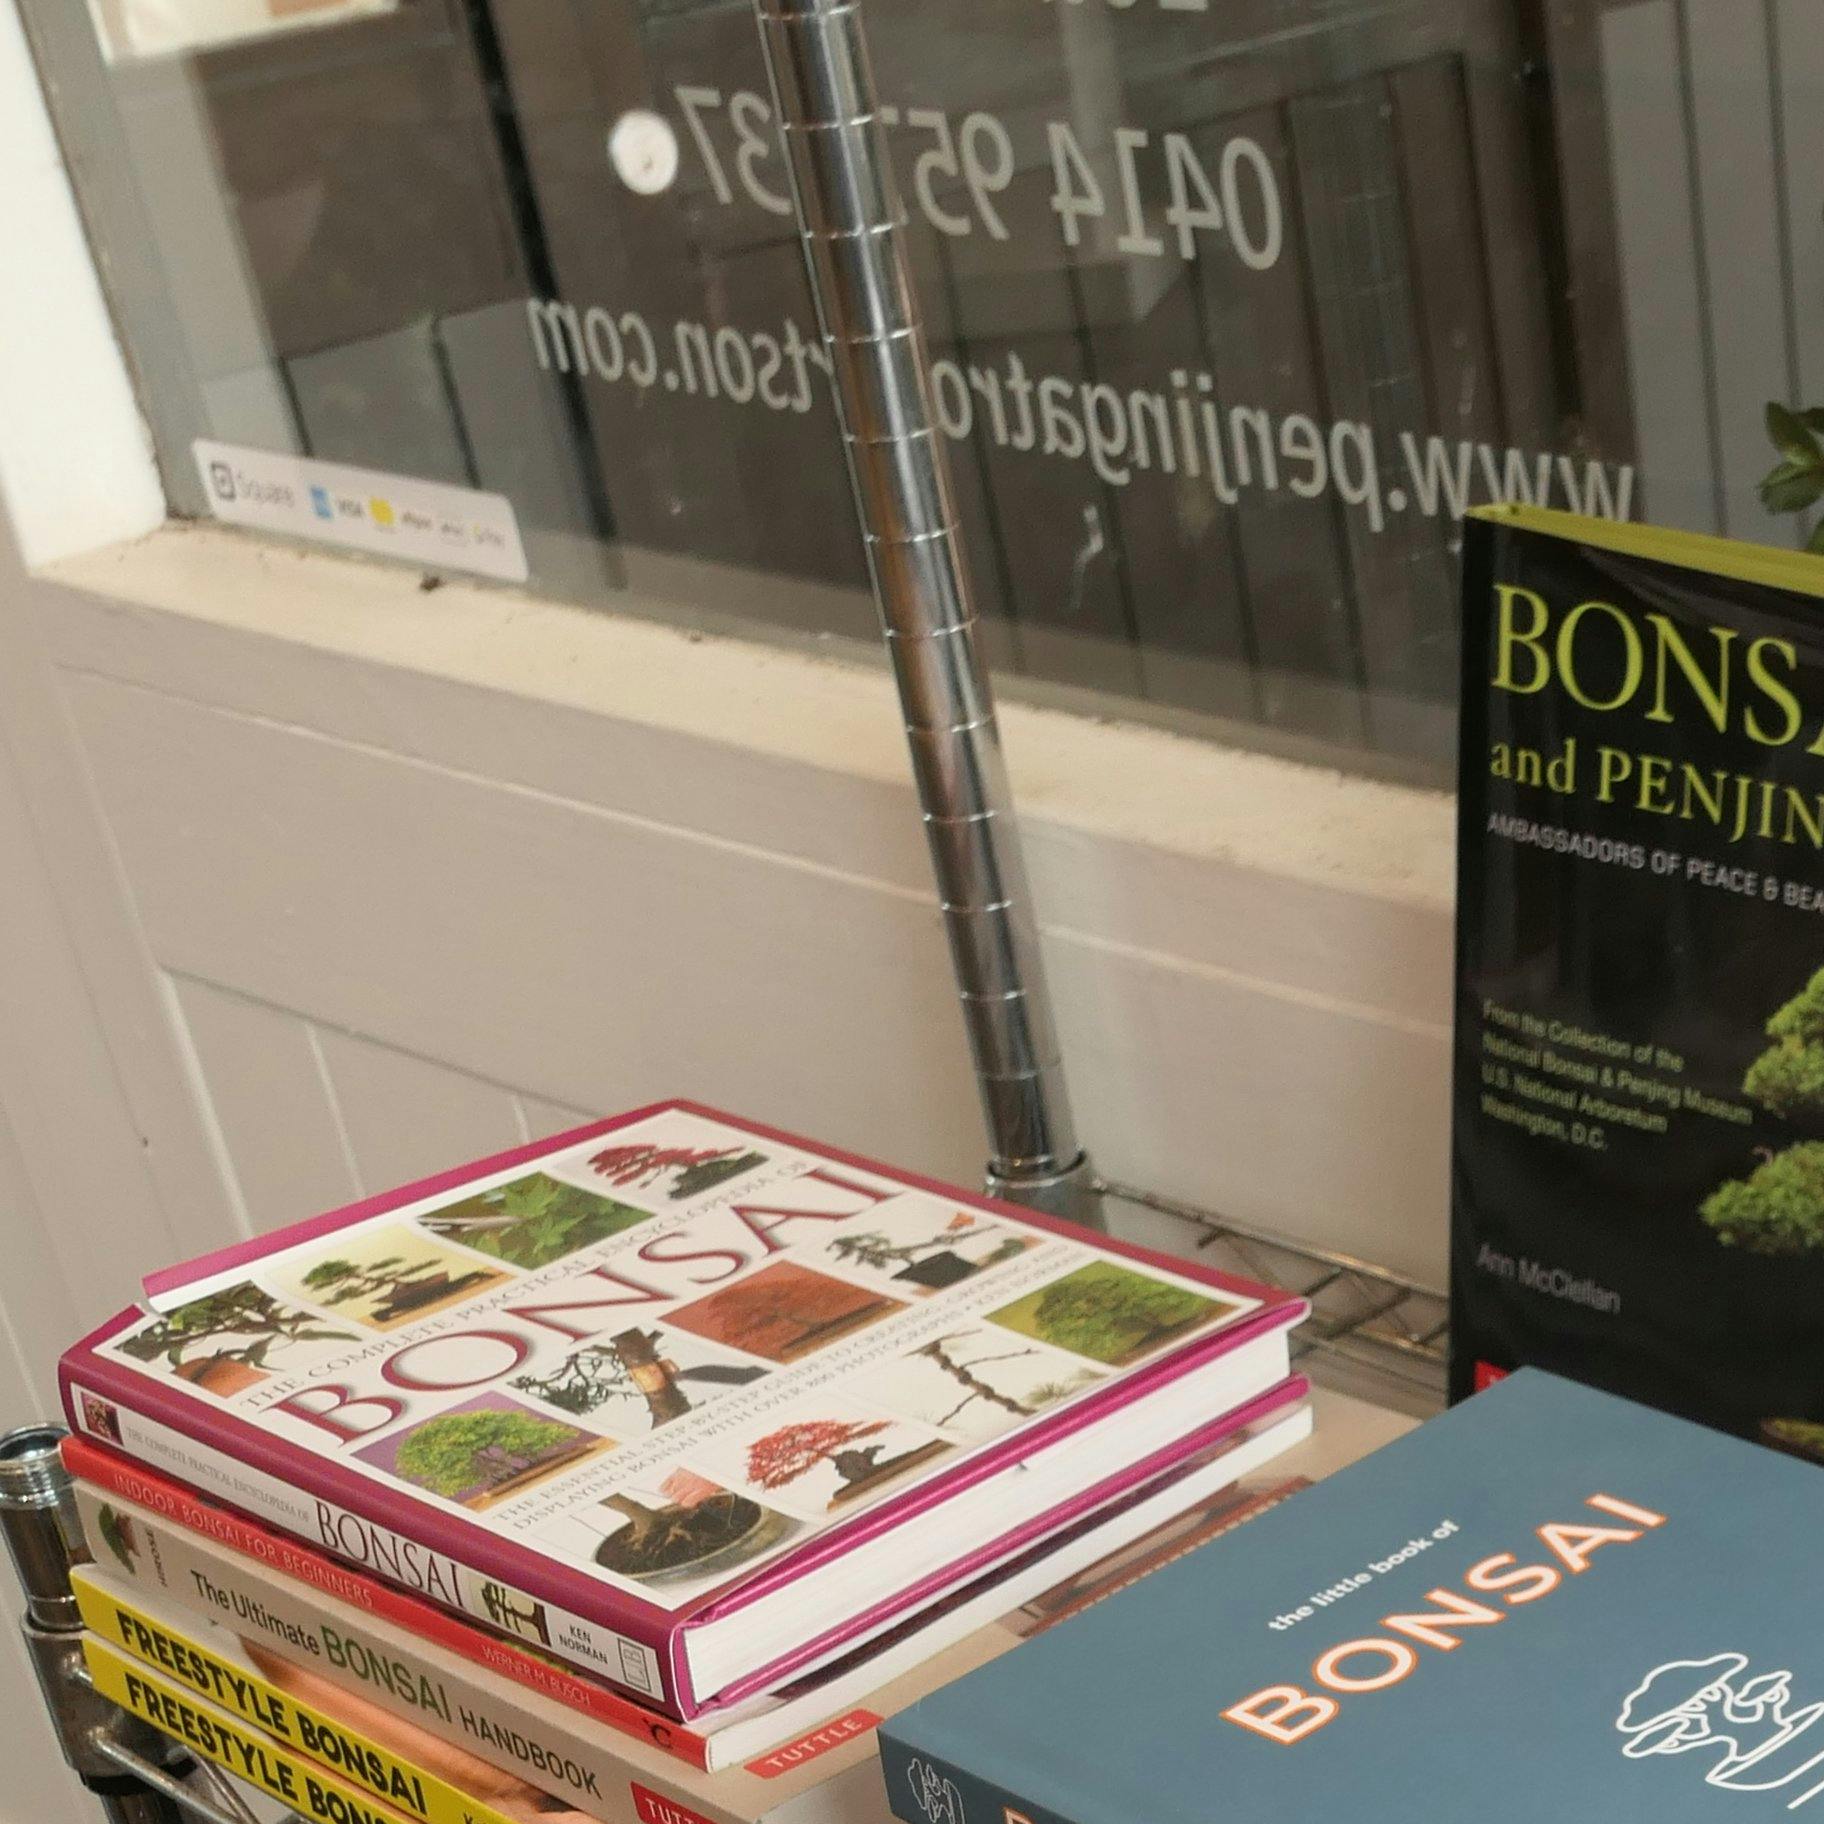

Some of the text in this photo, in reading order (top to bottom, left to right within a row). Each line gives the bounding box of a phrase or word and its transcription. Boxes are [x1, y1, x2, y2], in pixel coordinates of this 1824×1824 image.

[1489, 738, 1577, 794] and
[257, 1167, 905, 1449] BONSAI
[114, 1472, 176, 1516] INDOOR
[182, 1503, 240, 1546] BONSAI
[245, 1531, 278, 1562] FOR
[282, 1549, 376, 1609] BEGINNERS
[315, 1500, 464, 1608] BONSAI
[1267, 1518, 1461, 1632] the little book of
[558, 1634, 609, 1666] NORMAN
[569, 1623, 592, 1644] KEN
[1219, 1493, 1668, 1745] BONSAI
[114, 1608, 290, 1729] FREESTYLE
[294, 1708, 430, 1817] BONSAI
[124, 1673, 299, 1802] FREESTYLE
[190, 1569, 603, 1801] The Ultimate BONSAI HANDBOOK
[763, 1718, 865, 1771] TUTTLE
